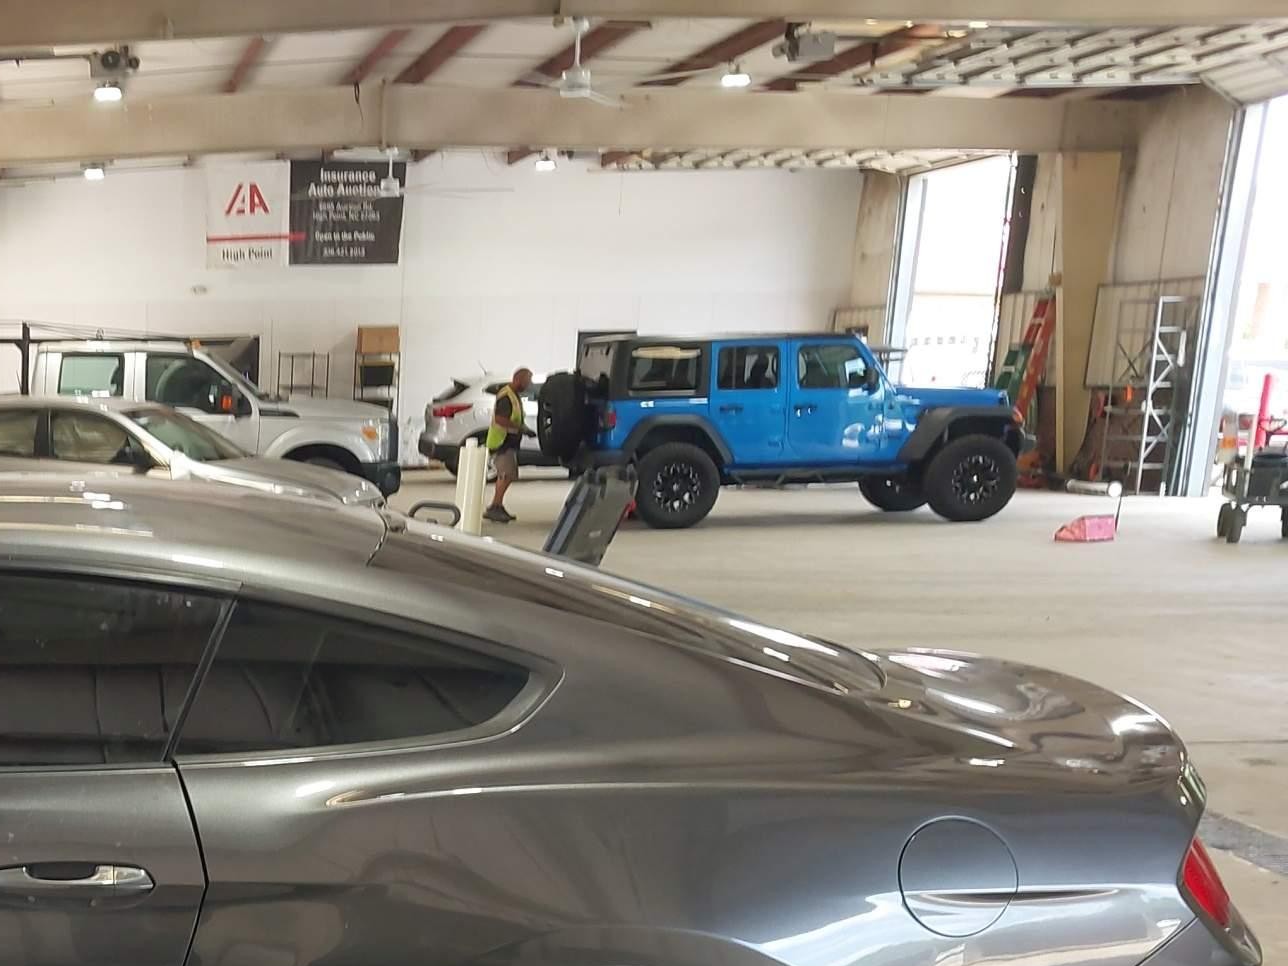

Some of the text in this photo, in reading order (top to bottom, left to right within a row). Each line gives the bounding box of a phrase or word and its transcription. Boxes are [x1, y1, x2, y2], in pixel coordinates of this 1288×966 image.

[320, 167, 376, 183] Insurance
[308, 182, 334, 197] Auto
[222, 247, 273, 262] High Point
